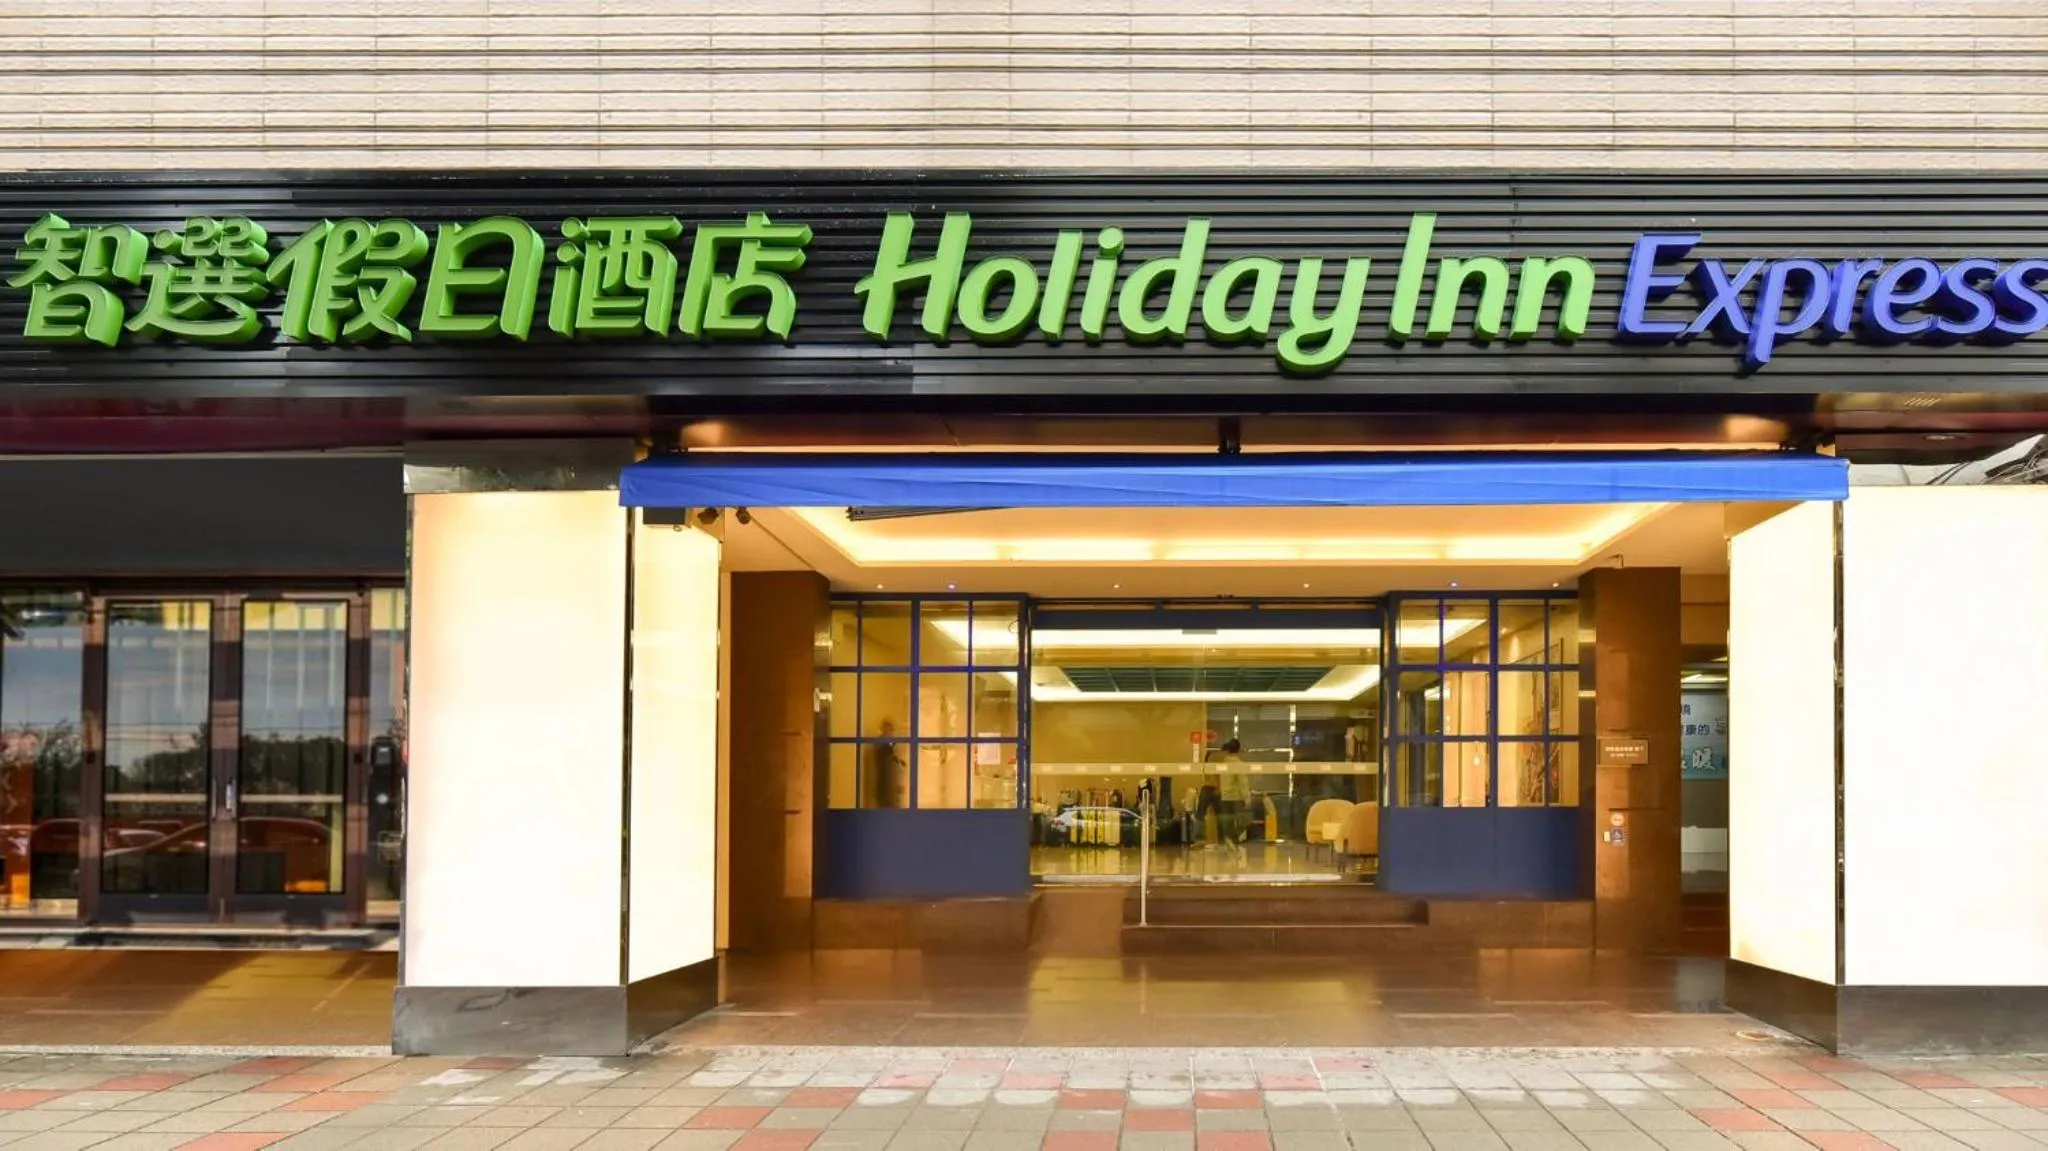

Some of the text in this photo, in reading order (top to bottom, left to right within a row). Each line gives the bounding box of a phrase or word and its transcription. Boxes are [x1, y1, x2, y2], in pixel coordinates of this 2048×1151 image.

[7, 211, 814, 347] 智選假日酒店
[854, 211, 2048, 375] Holiday Inn Express
